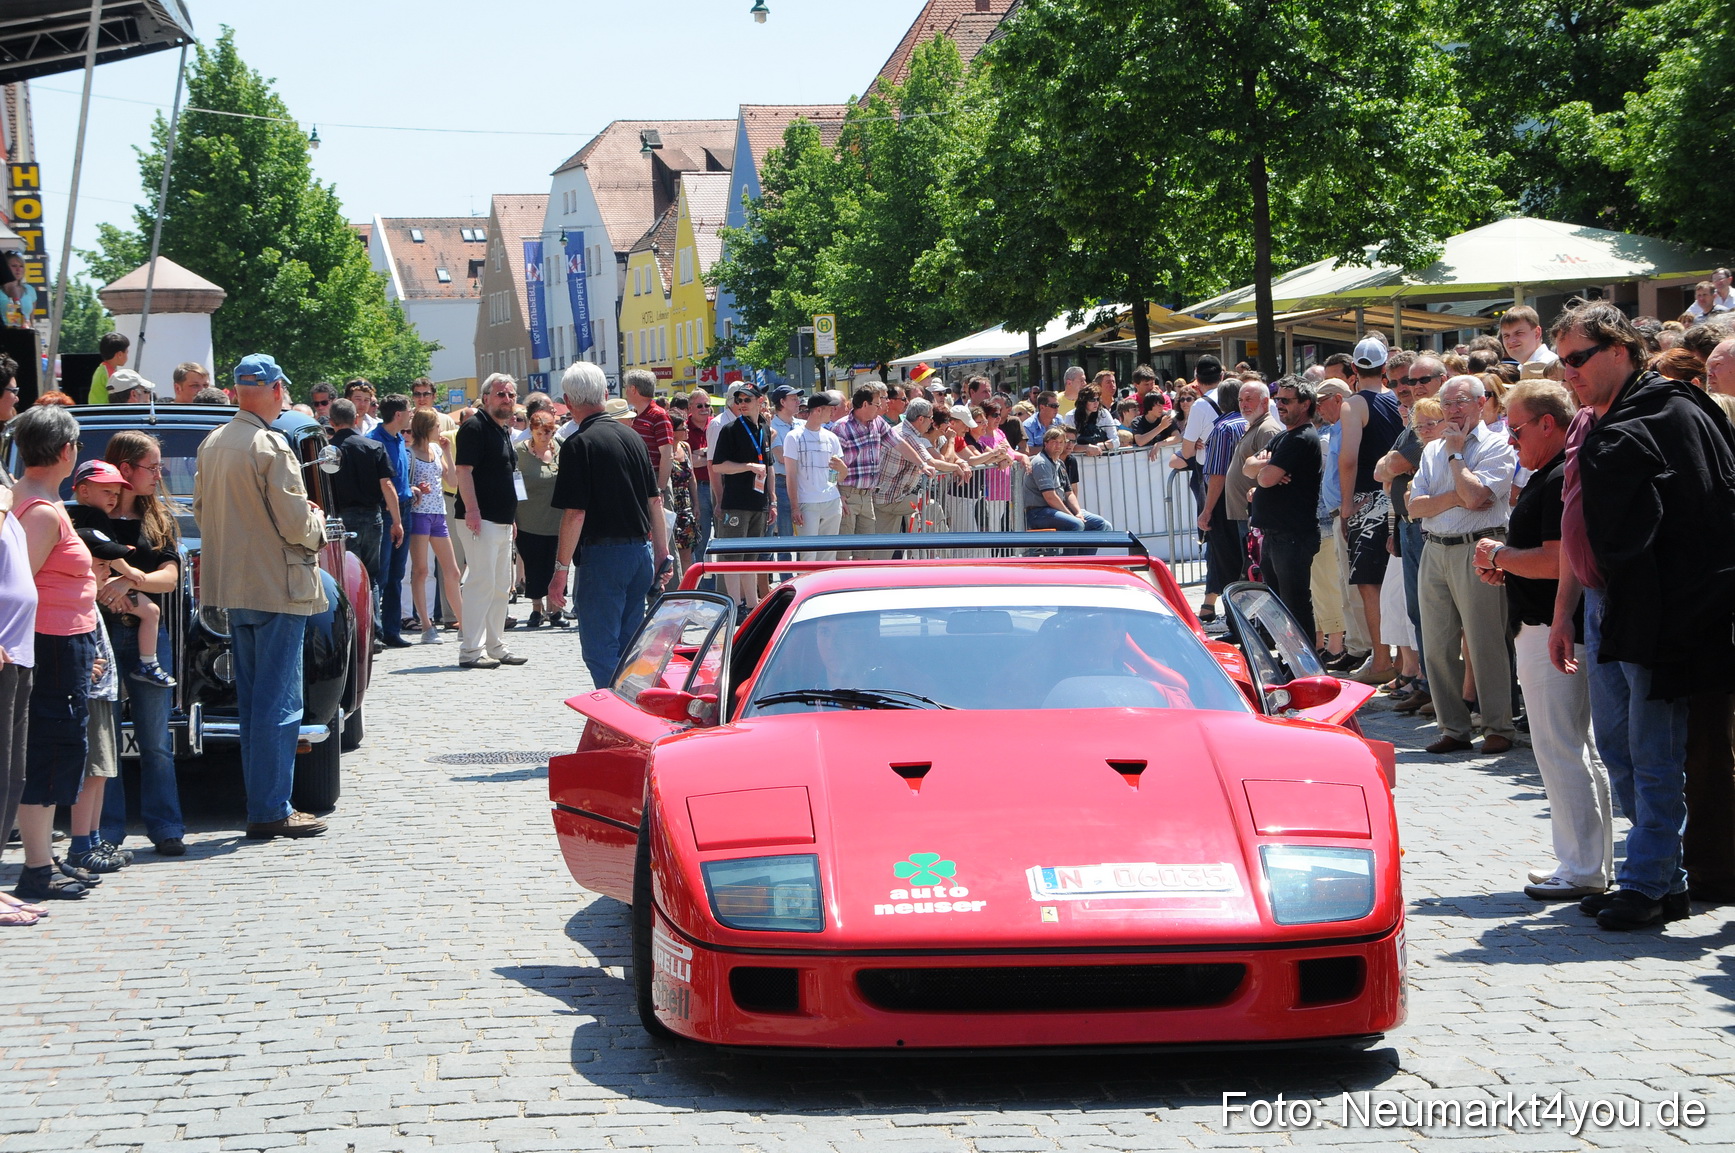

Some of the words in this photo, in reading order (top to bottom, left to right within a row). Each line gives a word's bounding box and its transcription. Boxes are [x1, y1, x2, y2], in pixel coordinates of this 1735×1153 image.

[575, 277, 587, 320] RUPPERT
[530, 375, 547, 390] KL
[1058, 869, 1083, 889] N
[1113, 866, 1226, 888] 06035
[889, 886, 969, 900] auto
[874, 900, 987, 915] neuser
